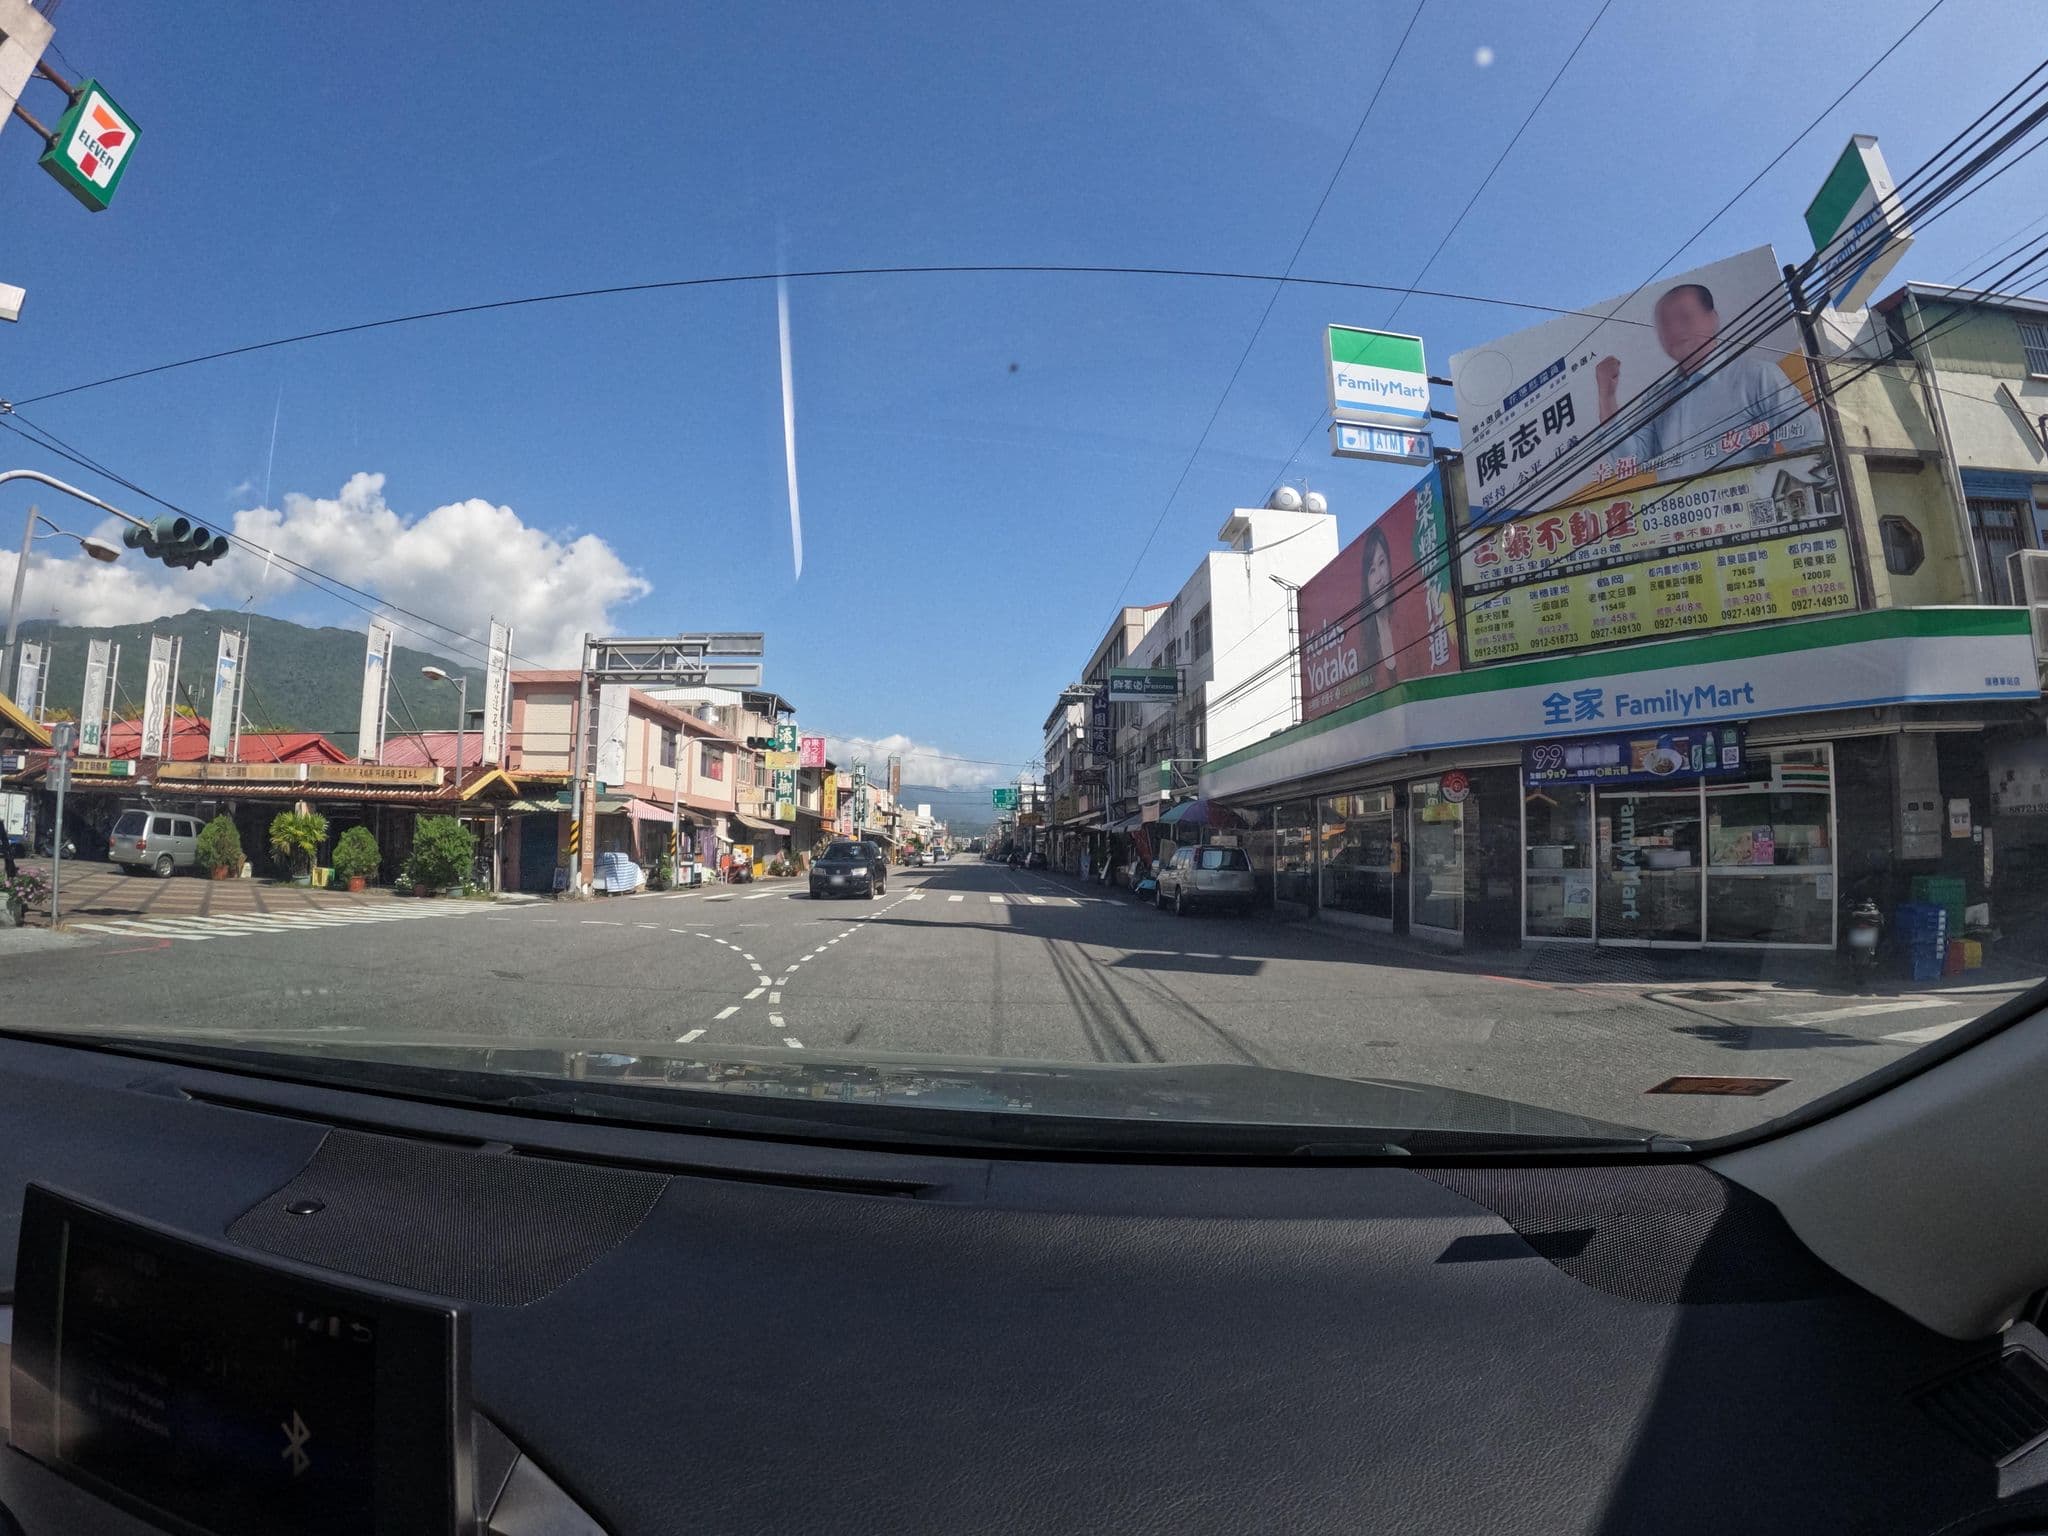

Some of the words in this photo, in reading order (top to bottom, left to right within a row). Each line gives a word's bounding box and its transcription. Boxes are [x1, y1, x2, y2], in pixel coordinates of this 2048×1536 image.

[1337, 373, 1425, 399] FamilyMart
[1476, 392, 1576, 488] 陳志明
[1793, 553, 1836, 568] 民權東路
[1415, 482, 1450, 671] 榮耀花蓮
[1721, 603, 1777, 620] 0927-149130
[1791, 594, 1849, 612] 0927-149130
[1654, 613, 1708, 629] 0927-149130
[1591, 623, 1641, 639] 0927-149130
[1530, 633, 1579, 648] 0912-518733
[1474, 643, 1519, 657] 0912-518733
[1308, 648, 1359, 693] Yotaka
[1542, 687, 1604, 725] 全家
[1616, 681, 1754, 719] FamilyMart
